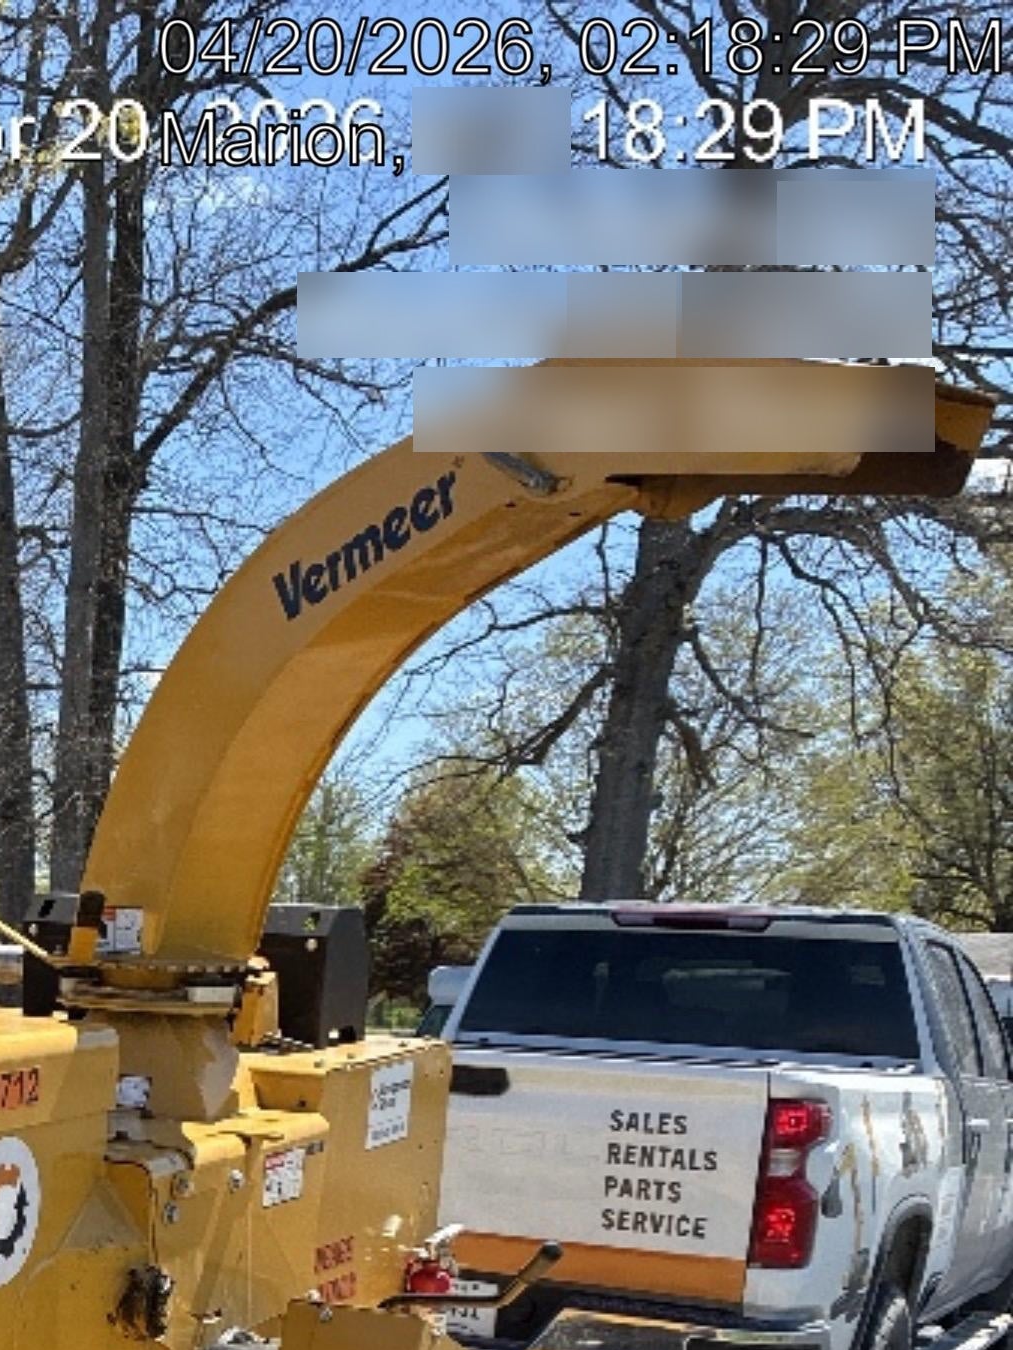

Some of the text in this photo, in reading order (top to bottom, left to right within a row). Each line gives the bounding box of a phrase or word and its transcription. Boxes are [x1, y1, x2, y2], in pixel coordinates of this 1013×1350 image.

[271, 470, 456, 622] Vermeer
[610, 1109, 688, 1136] SALES
[606, 1142, 718, 1172] RENTALS
[604, 1175, 682, 1204] PARTS
[600, 1208, 709, 1240] SERVICE
